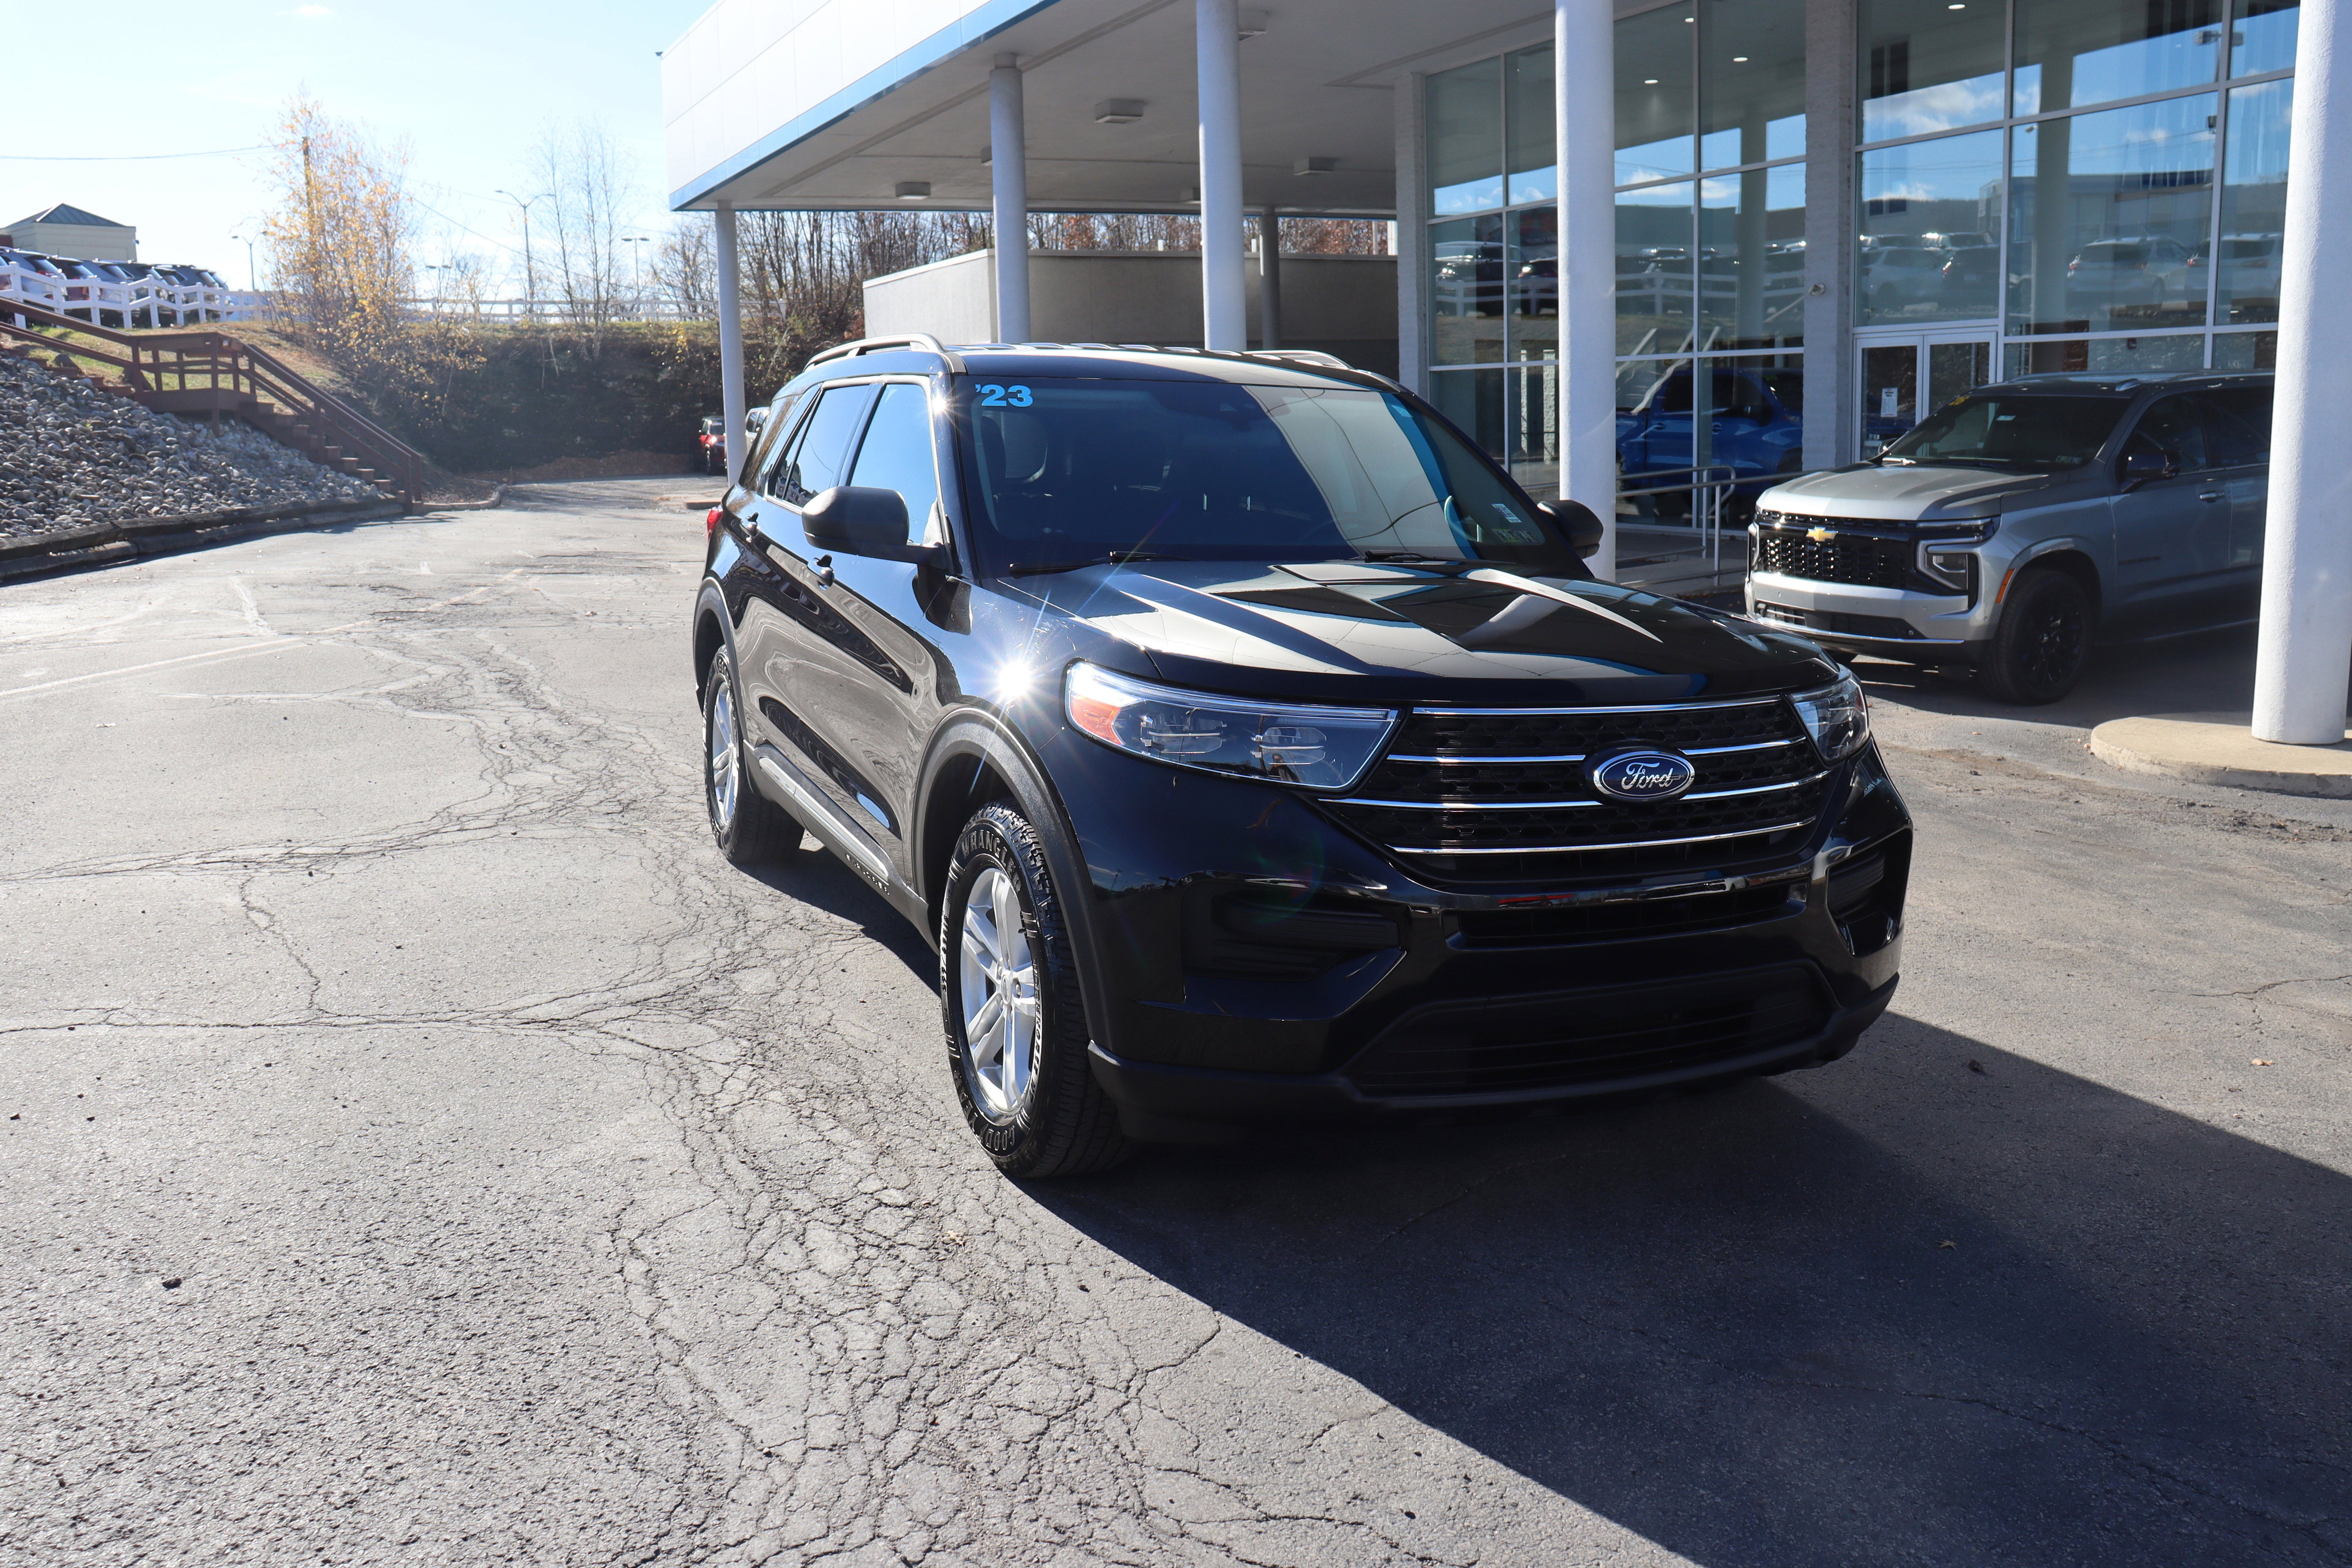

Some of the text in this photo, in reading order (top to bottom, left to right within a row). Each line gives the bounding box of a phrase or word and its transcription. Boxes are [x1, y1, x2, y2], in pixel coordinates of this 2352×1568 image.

[975, 384, 1033, 407] '23
[1621, 762, 1674, 790] Ford
[962, 829, 1021, 892] WRANGLER
